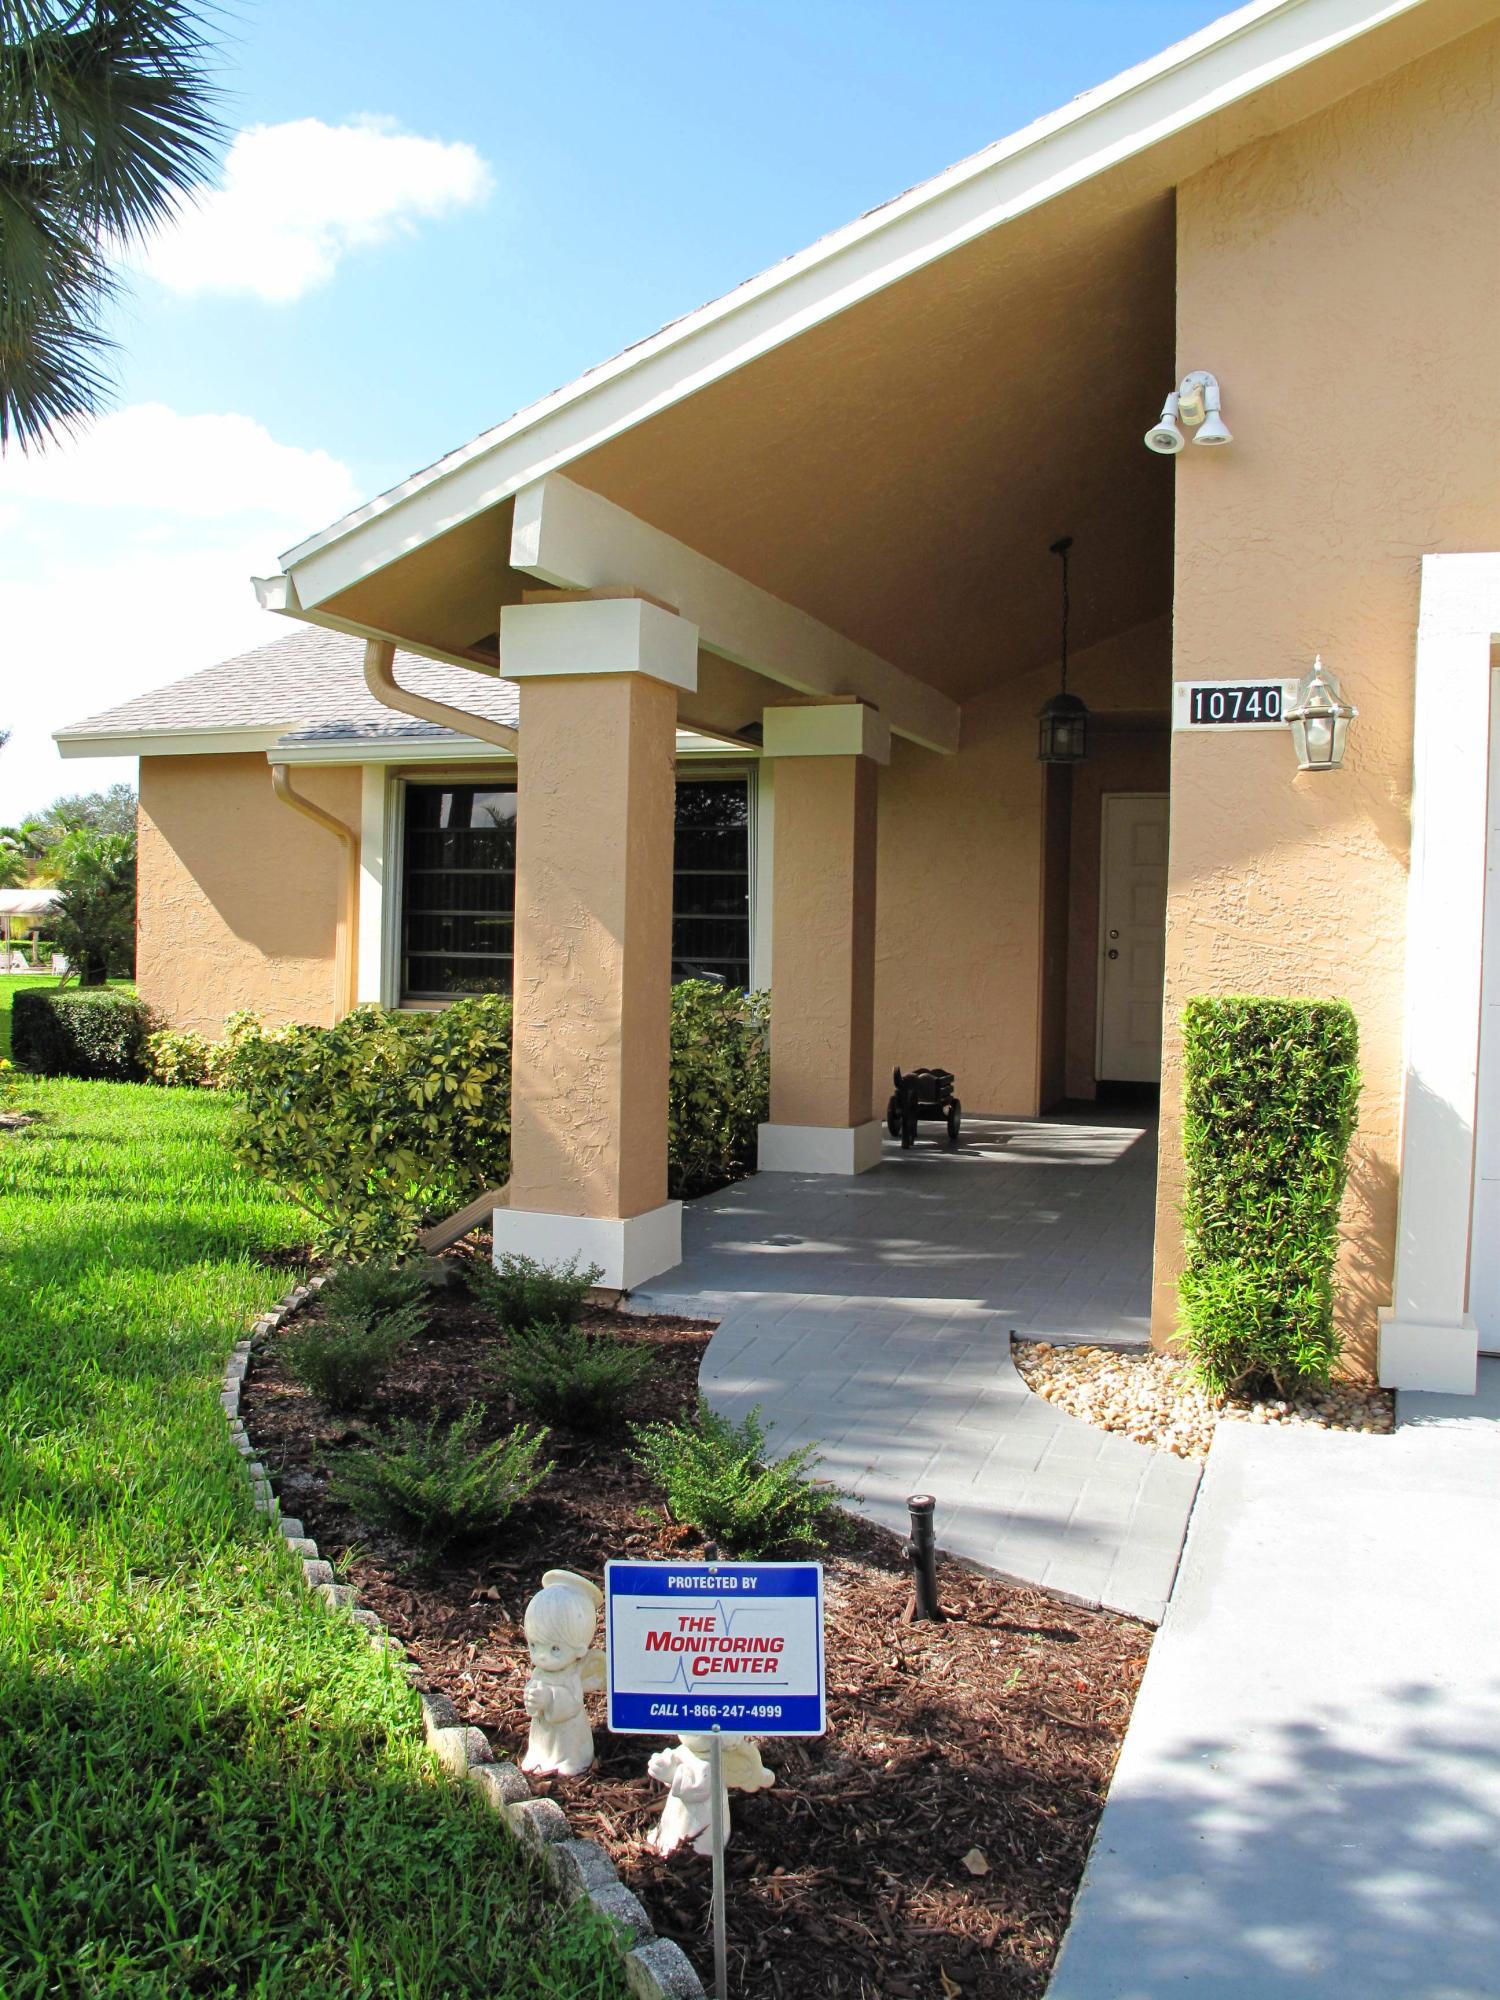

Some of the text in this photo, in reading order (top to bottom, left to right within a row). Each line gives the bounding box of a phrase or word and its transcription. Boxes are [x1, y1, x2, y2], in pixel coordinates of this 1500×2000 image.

[1196, 691, 1280, 719] 10740
[668, 1576, 757, 1589] PROTECTED BY
[678, 1616, 716, 1632] THE
[645, 1631, 784, 1653] MONITORING
[692, 1656, 778, 1676] CENTER
[650, 1703, 782, 1718] CALL 1-866-247-4999
